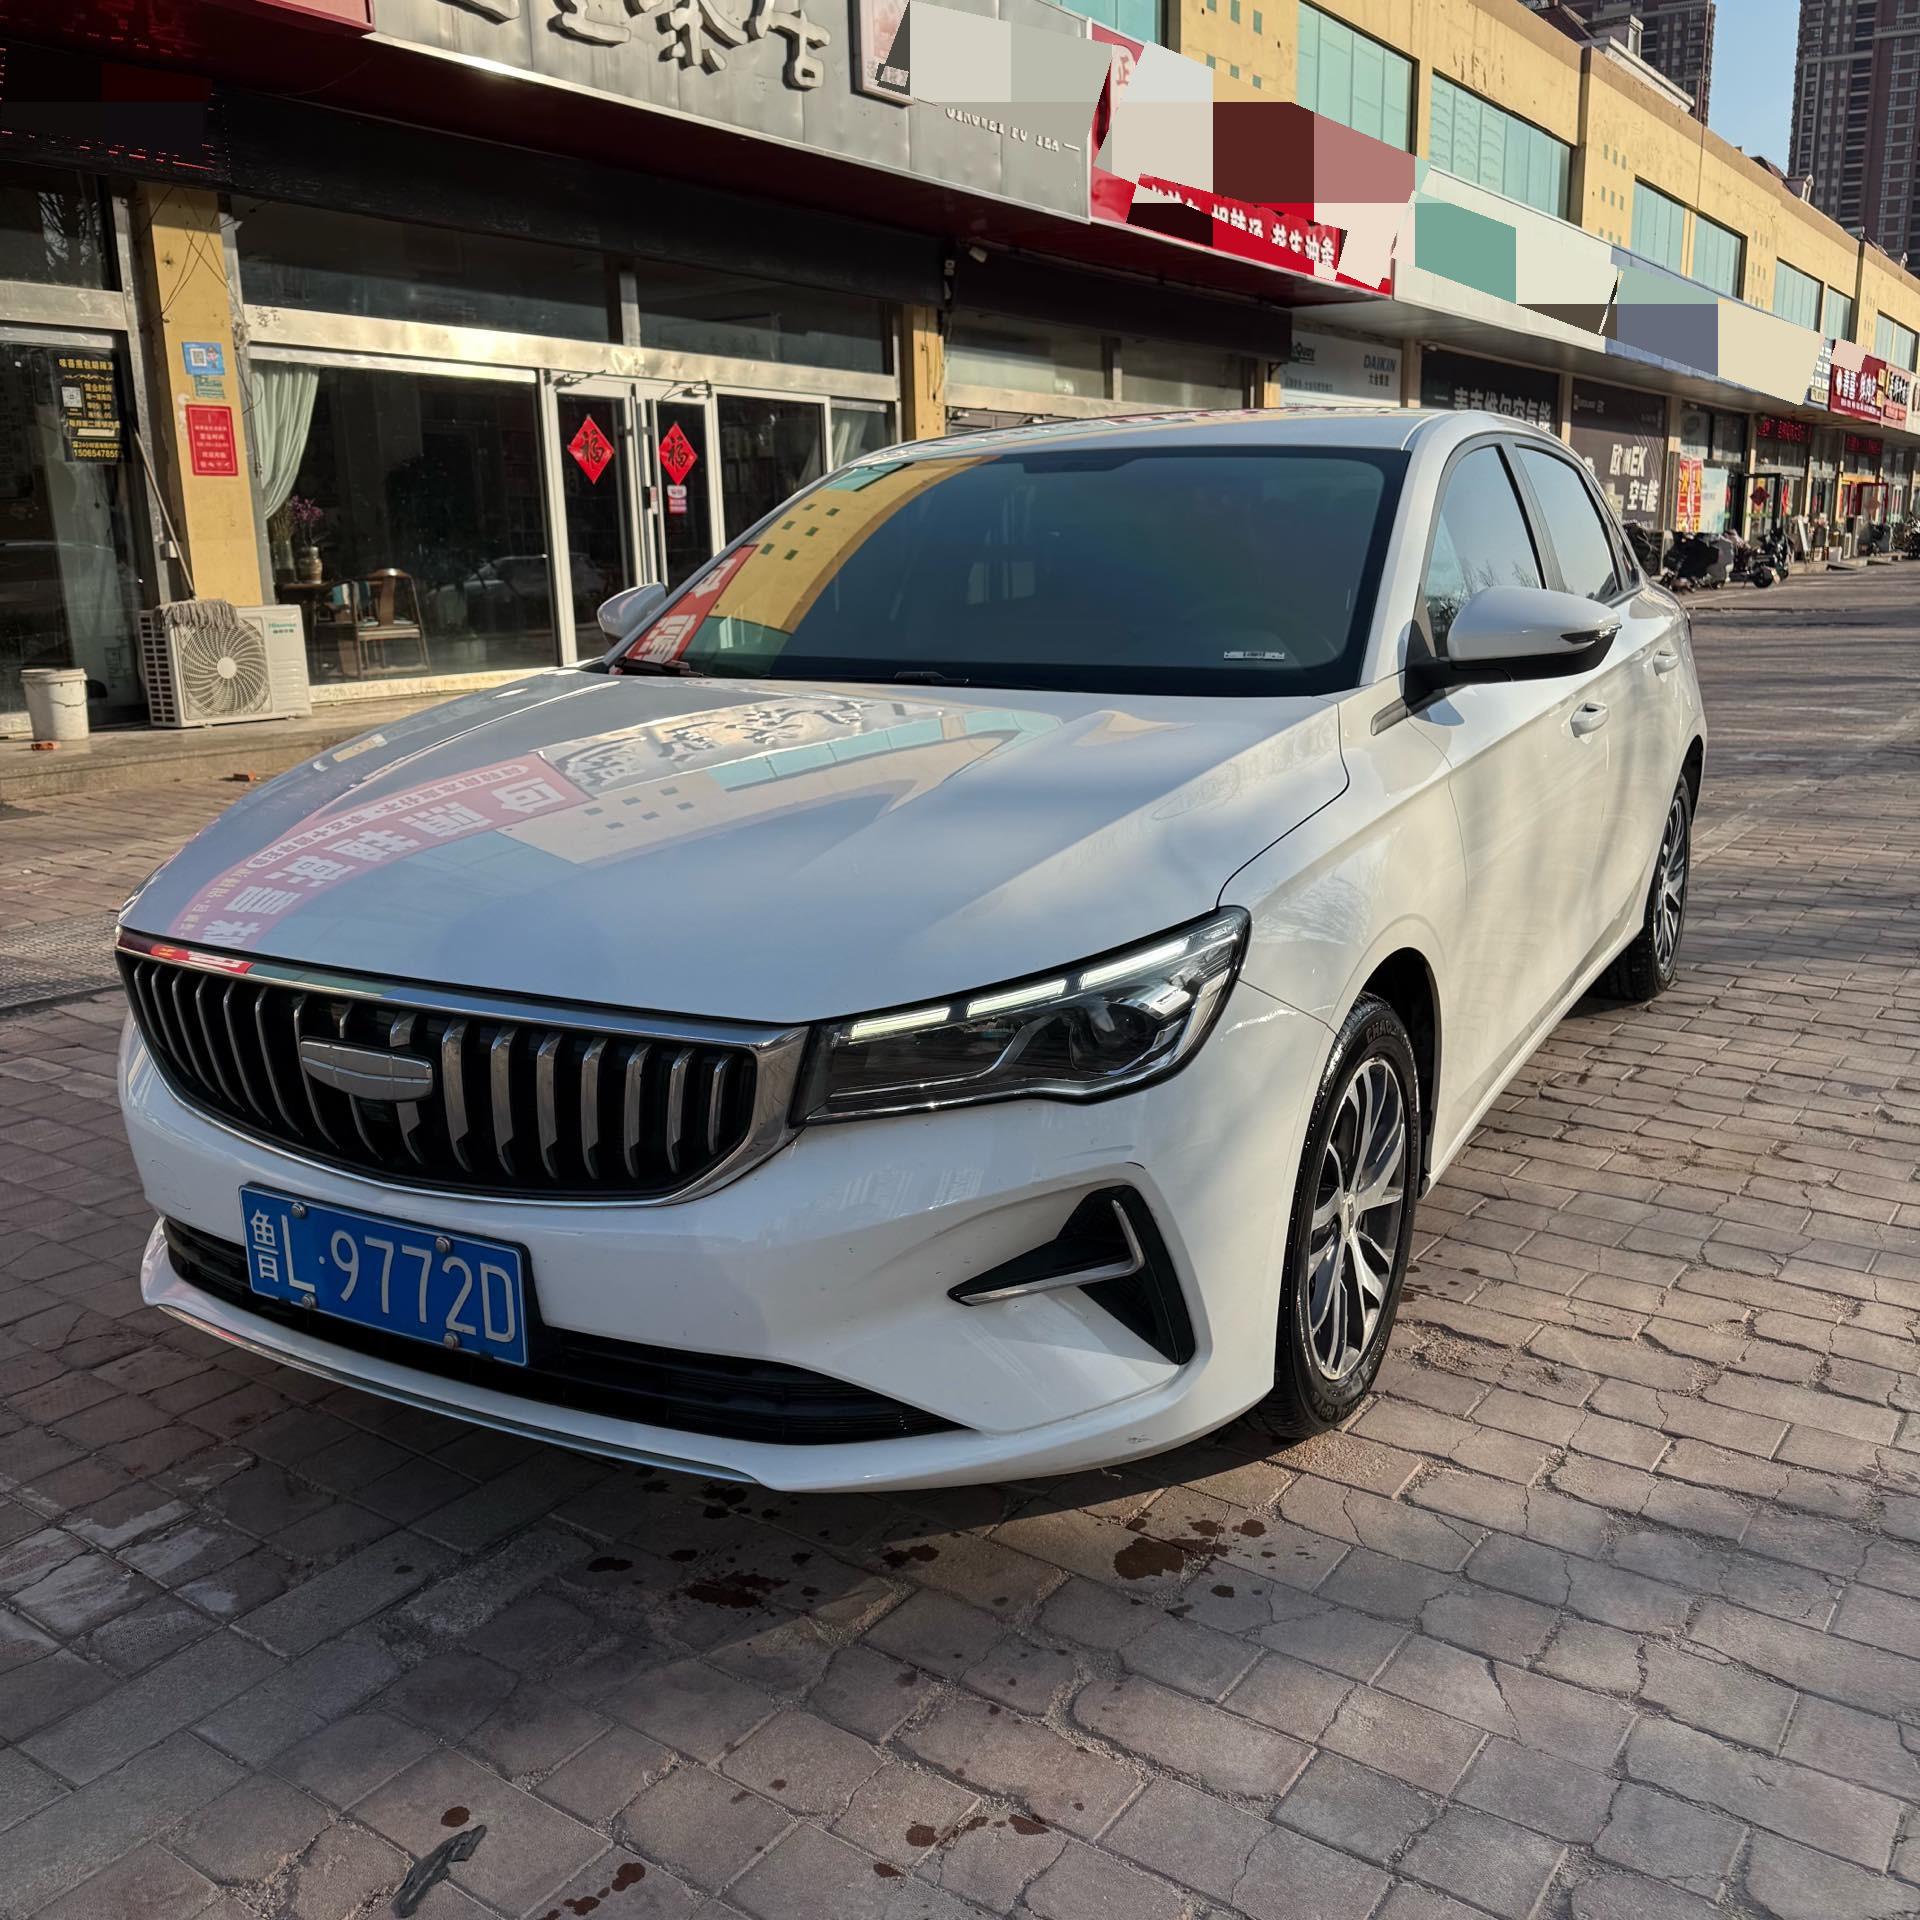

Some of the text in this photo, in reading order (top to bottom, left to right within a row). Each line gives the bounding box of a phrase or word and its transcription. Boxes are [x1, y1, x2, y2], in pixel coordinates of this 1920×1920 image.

[1363, 354, 1397, 373] DAIKIN
[580, 428, 605, 473] 福
[667, 434, 689, 473] 福
